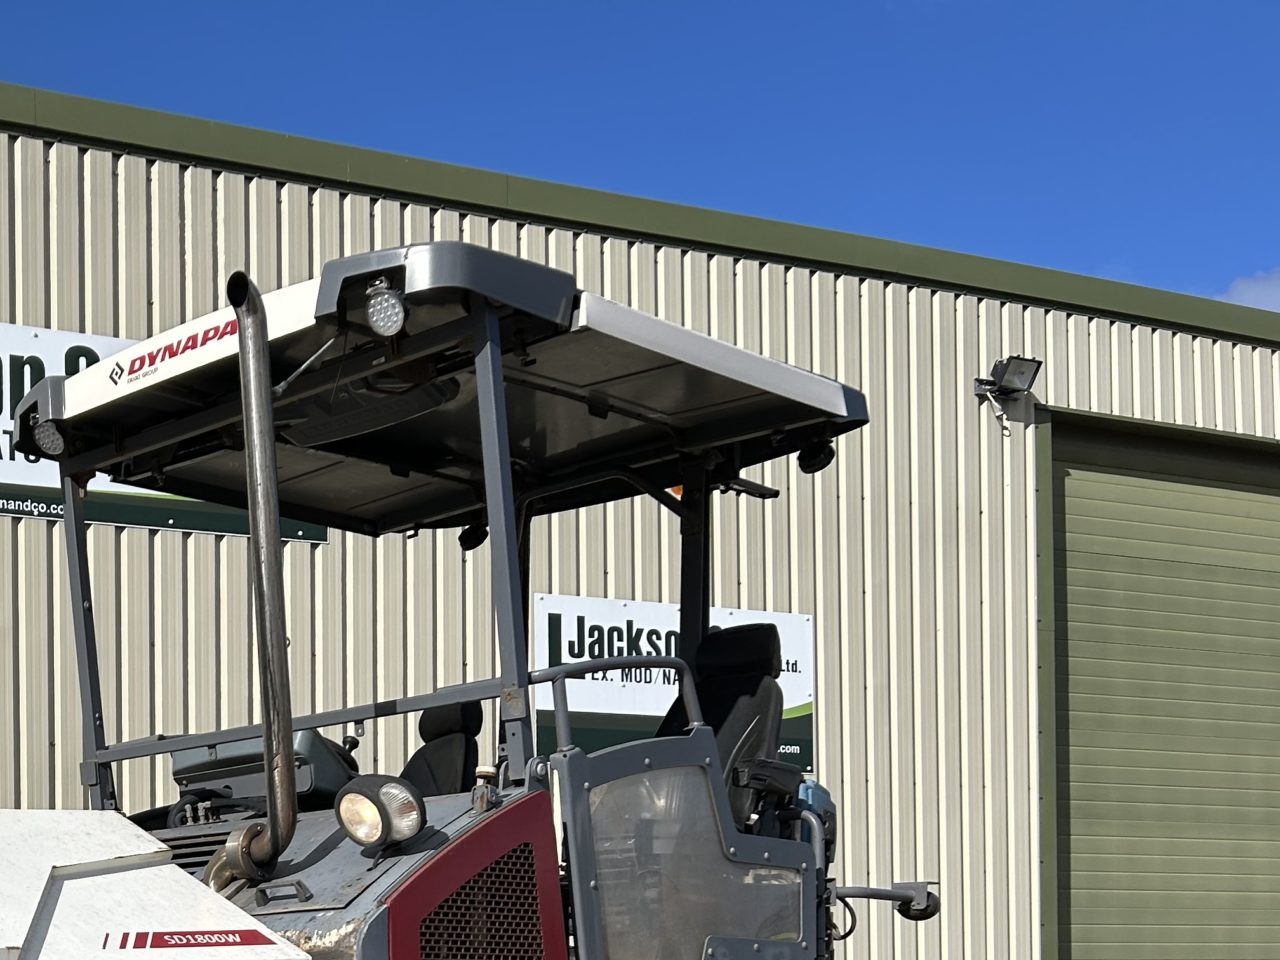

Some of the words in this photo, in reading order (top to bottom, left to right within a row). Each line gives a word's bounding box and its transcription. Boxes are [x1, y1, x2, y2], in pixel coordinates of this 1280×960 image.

[127, 318, 240, 377] DYNAPA
[568, 615, 680, 660] Jackso
[621, 667, 680, 685] MOD/NA
[163, 933, 242, 945] SD1800W
